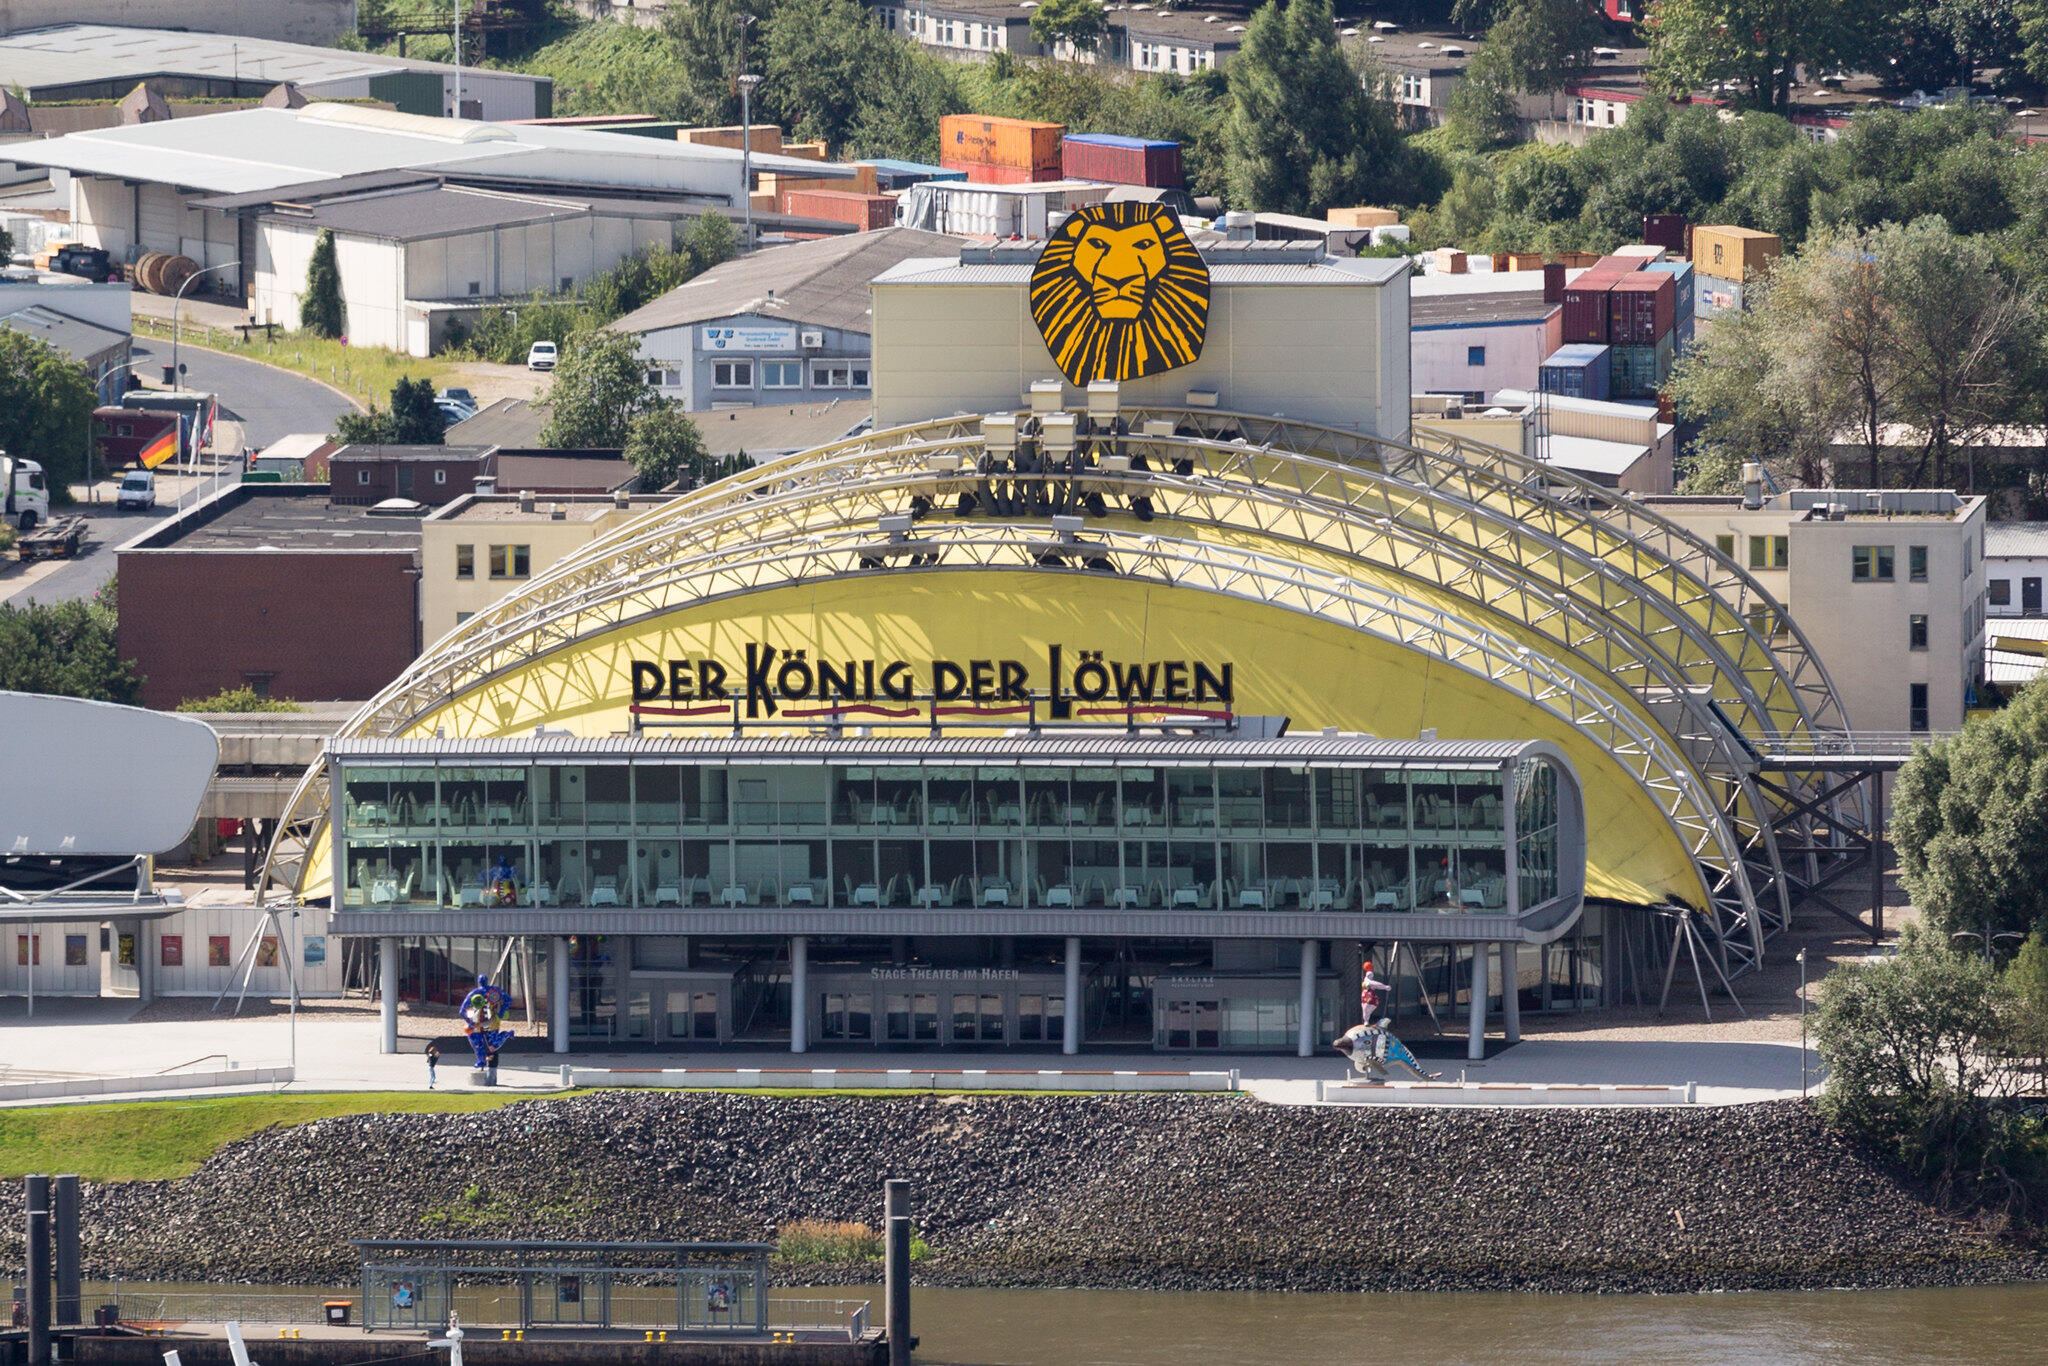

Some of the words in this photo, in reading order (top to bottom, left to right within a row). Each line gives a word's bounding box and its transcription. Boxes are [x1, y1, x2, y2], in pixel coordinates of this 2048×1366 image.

[631, 659, 730, 702] DER
[745, 642, 914, 719] KÖNIG
[931, 659, 1030, 702] DER
[1049, 643, 1234, 719] LÖWEN
[871, 967, 907, 980] STAGE
[910, 968, 960, 980] THEATER
[963, 969, 978, 980] IM
[981, 968, 1019, 980] HAFEN
